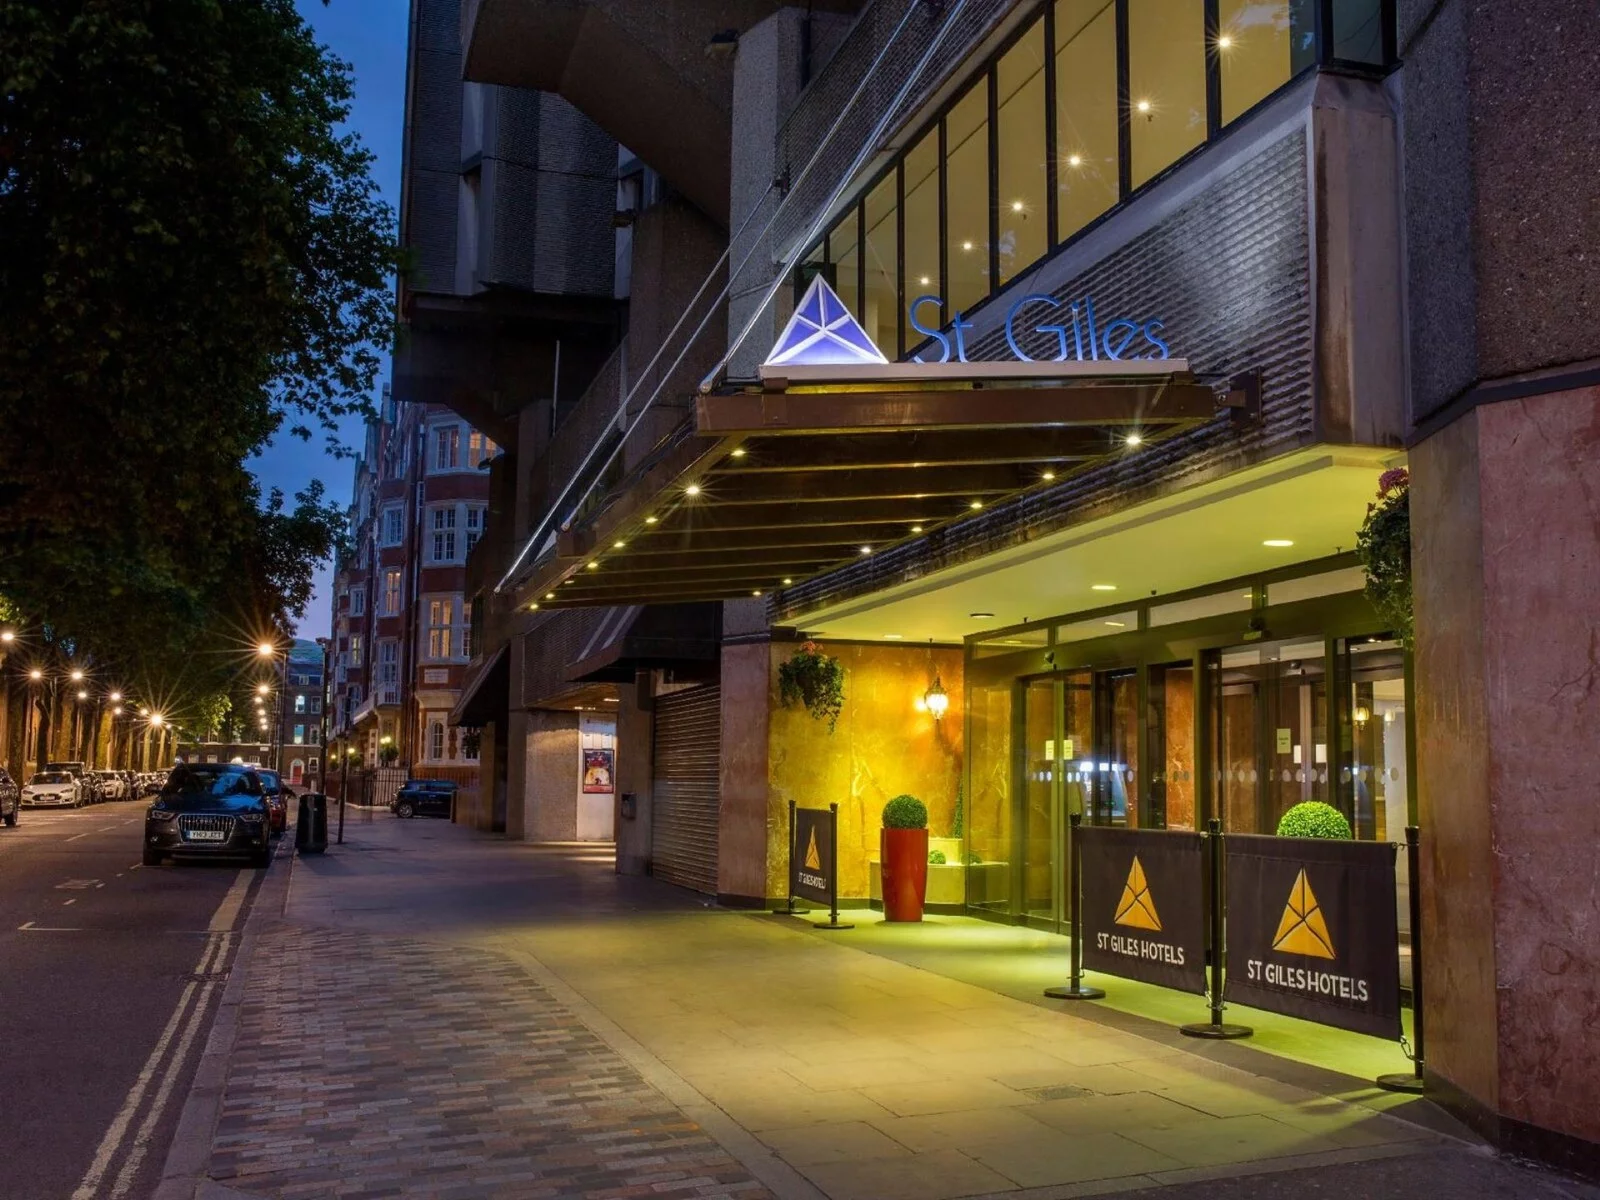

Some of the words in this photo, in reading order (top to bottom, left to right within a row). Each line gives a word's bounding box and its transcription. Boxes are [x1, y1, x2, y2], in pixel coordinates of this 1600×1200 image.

[909, 295, 973, 363] St
[1006, 294, 1170, 362] Giles
[1096, 932, 1110, 950] ST
[1111, 938, 1139, 957] GILES
[1141, 941, 1185, 965] HOTELS
[1248, 960, 1263, 980] ST
[1265, 964, 1306, 989] GILES
[1307, 970, 1369, 1001] HOTELS
